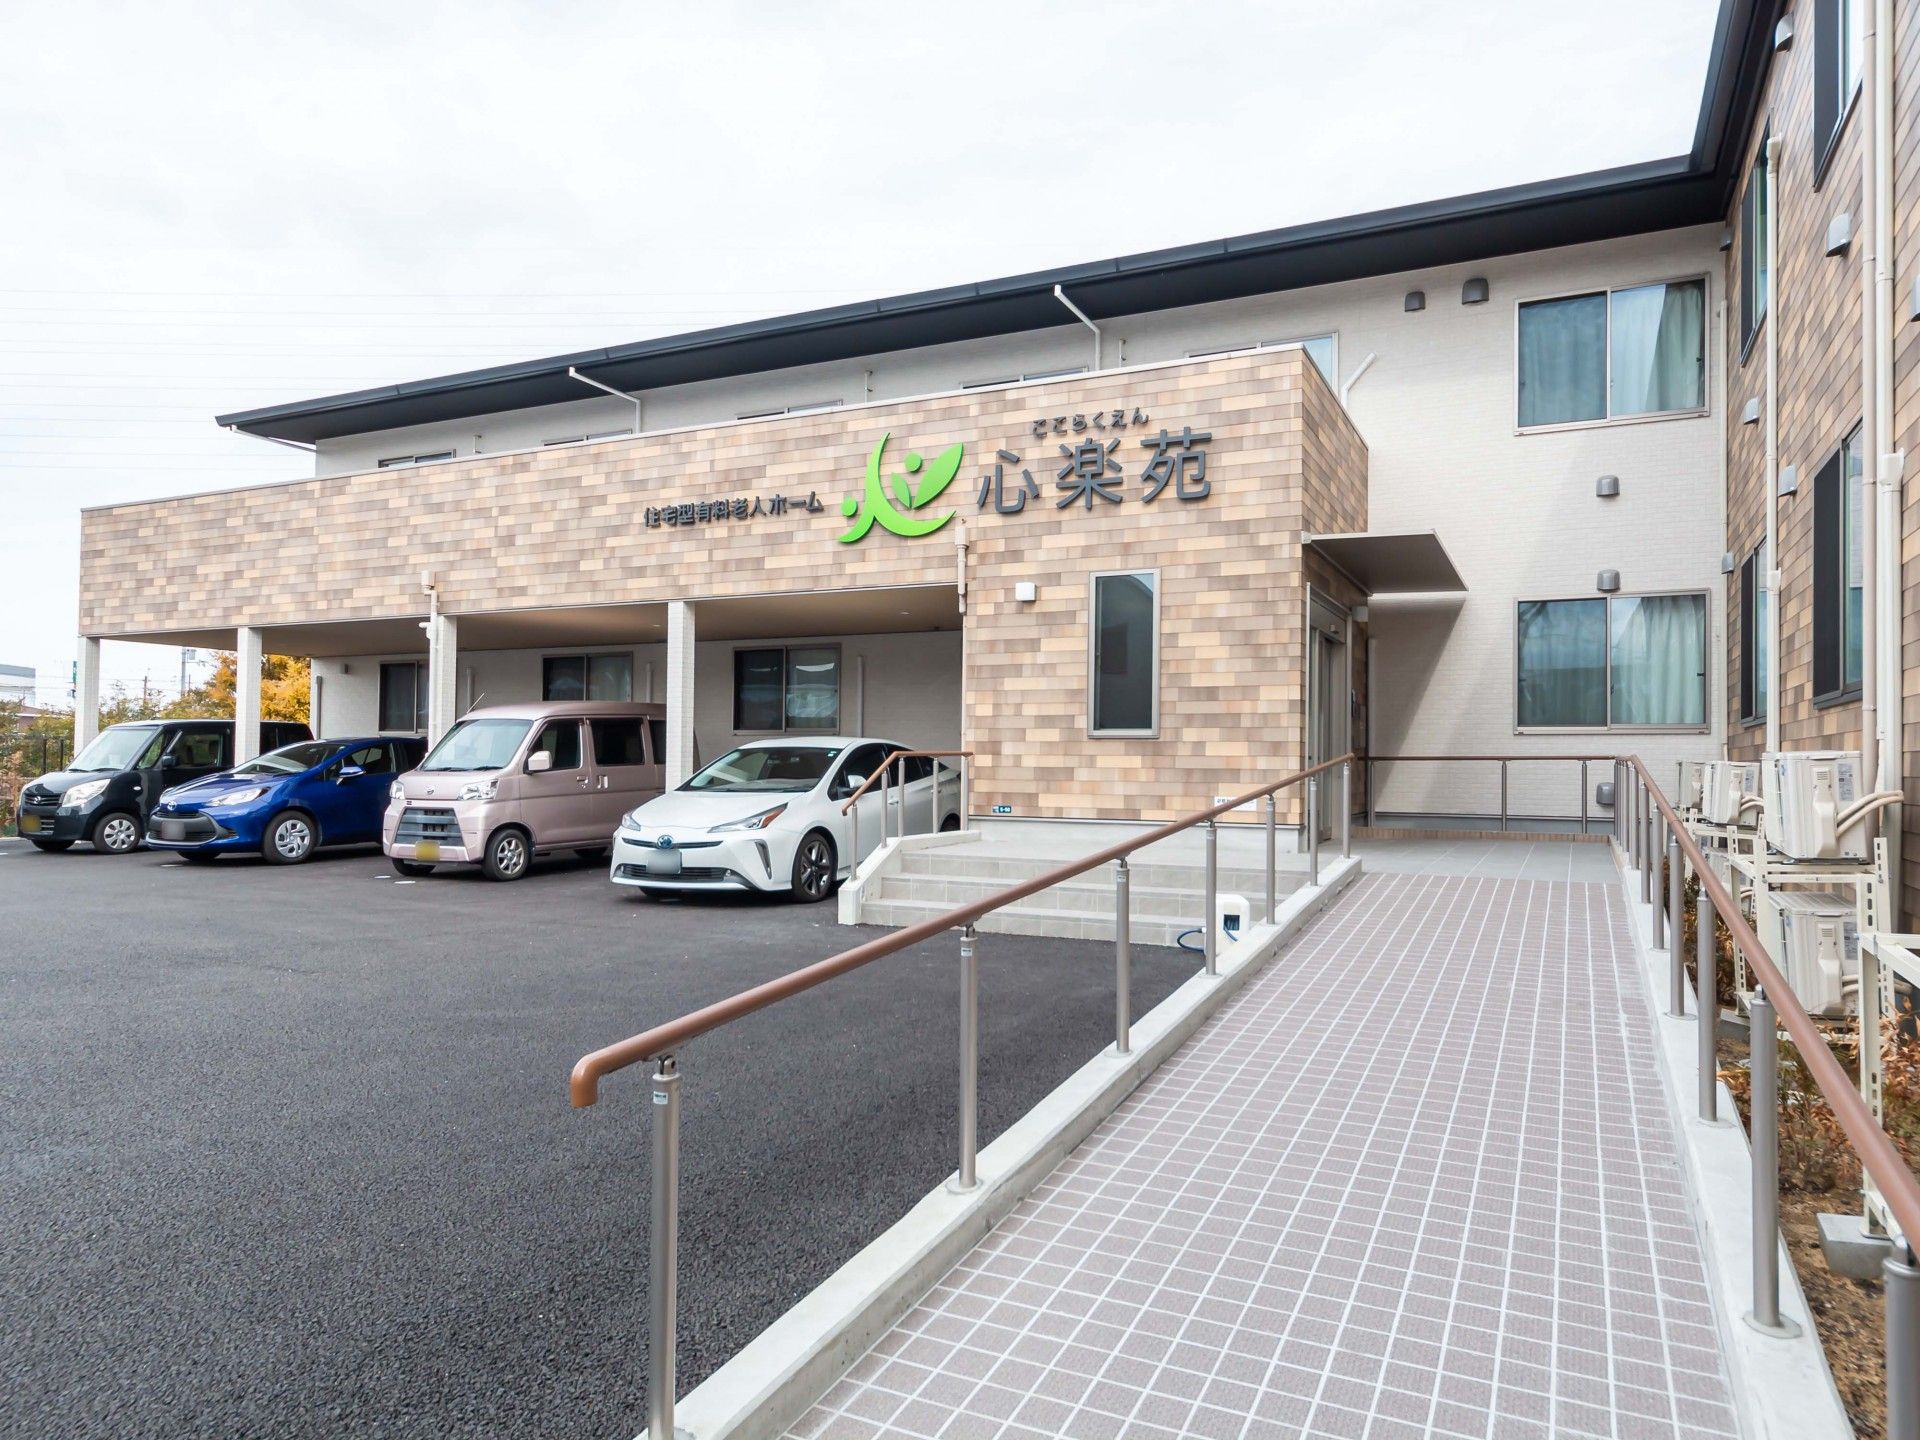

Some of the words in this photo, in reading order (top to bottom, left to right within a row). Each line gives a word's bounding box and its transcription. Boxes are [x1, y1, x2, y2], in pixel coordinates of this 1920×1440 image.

[1033, 407, 1149, 437] ここらくえん
[977, 426, 1212, 514] 心楽苑
[644, 491, 824, 528] 住宅型有料老人ホーム
